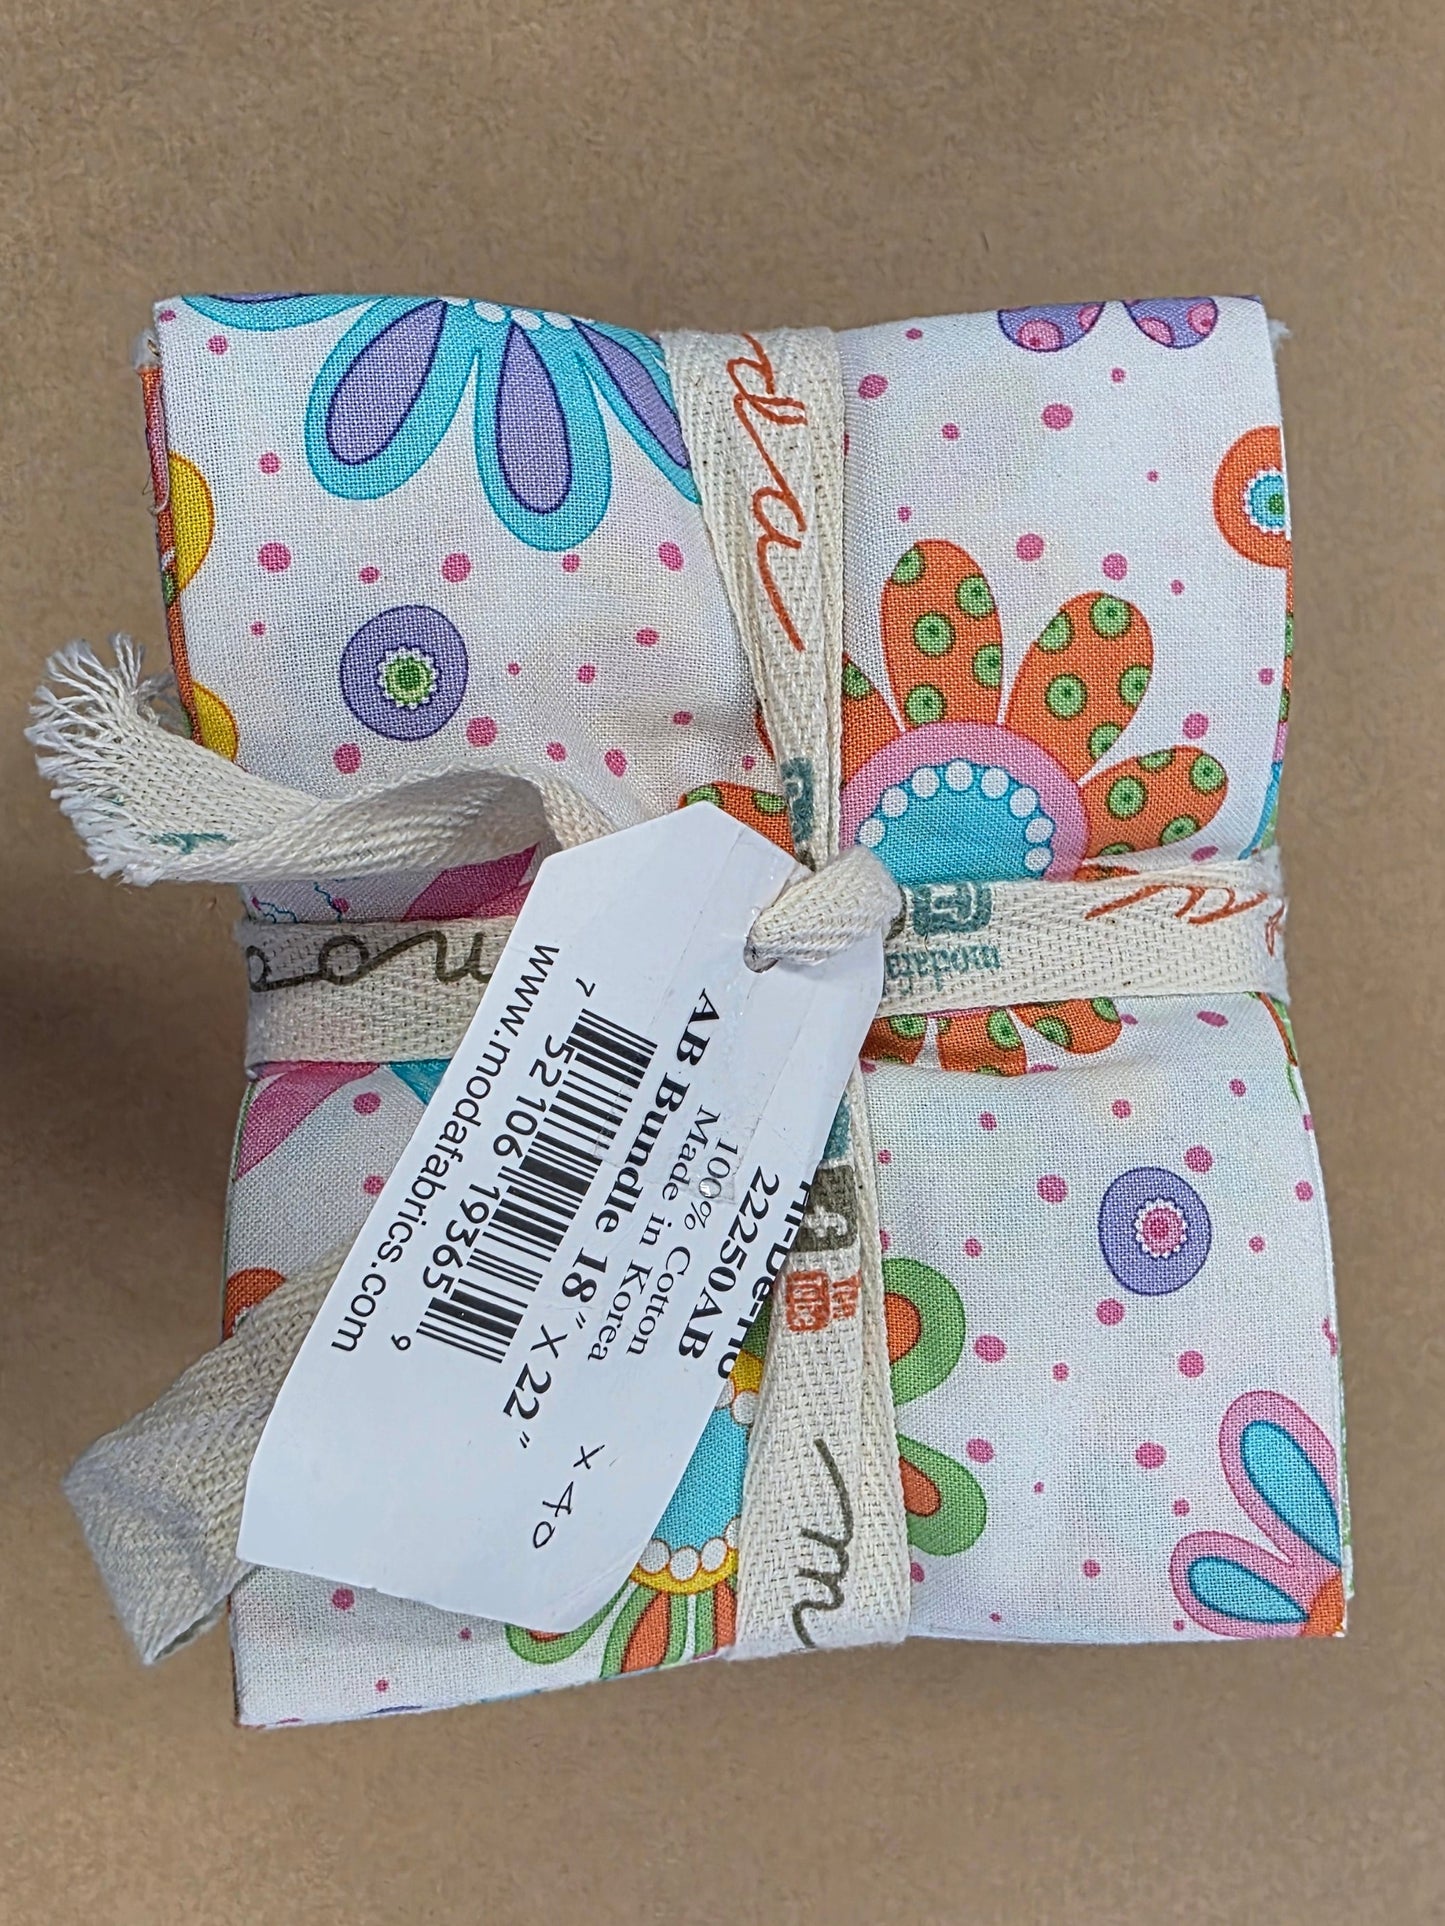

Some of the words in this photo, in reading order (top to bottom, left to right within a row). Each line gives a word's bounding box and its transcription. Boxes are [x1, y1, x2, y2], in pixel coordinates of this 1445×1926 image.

[676, 988, 721, 1066] AB
[331, 944, 560, 1352] www.modafabrics.com
[595, 1072, 691, 1233] Bundle
[662, 1104, 721, 1200] Made
[684, 1137, 738, 1230] 100%
[639, 1212, 673, 1246] in
[678, 1166, 779, 1359] 22250AB
[588, 1259, 653, 1361] Korea
[626, 1246, 691, 1355] Cotton
[790, 1274, 825, 1328] Tube
